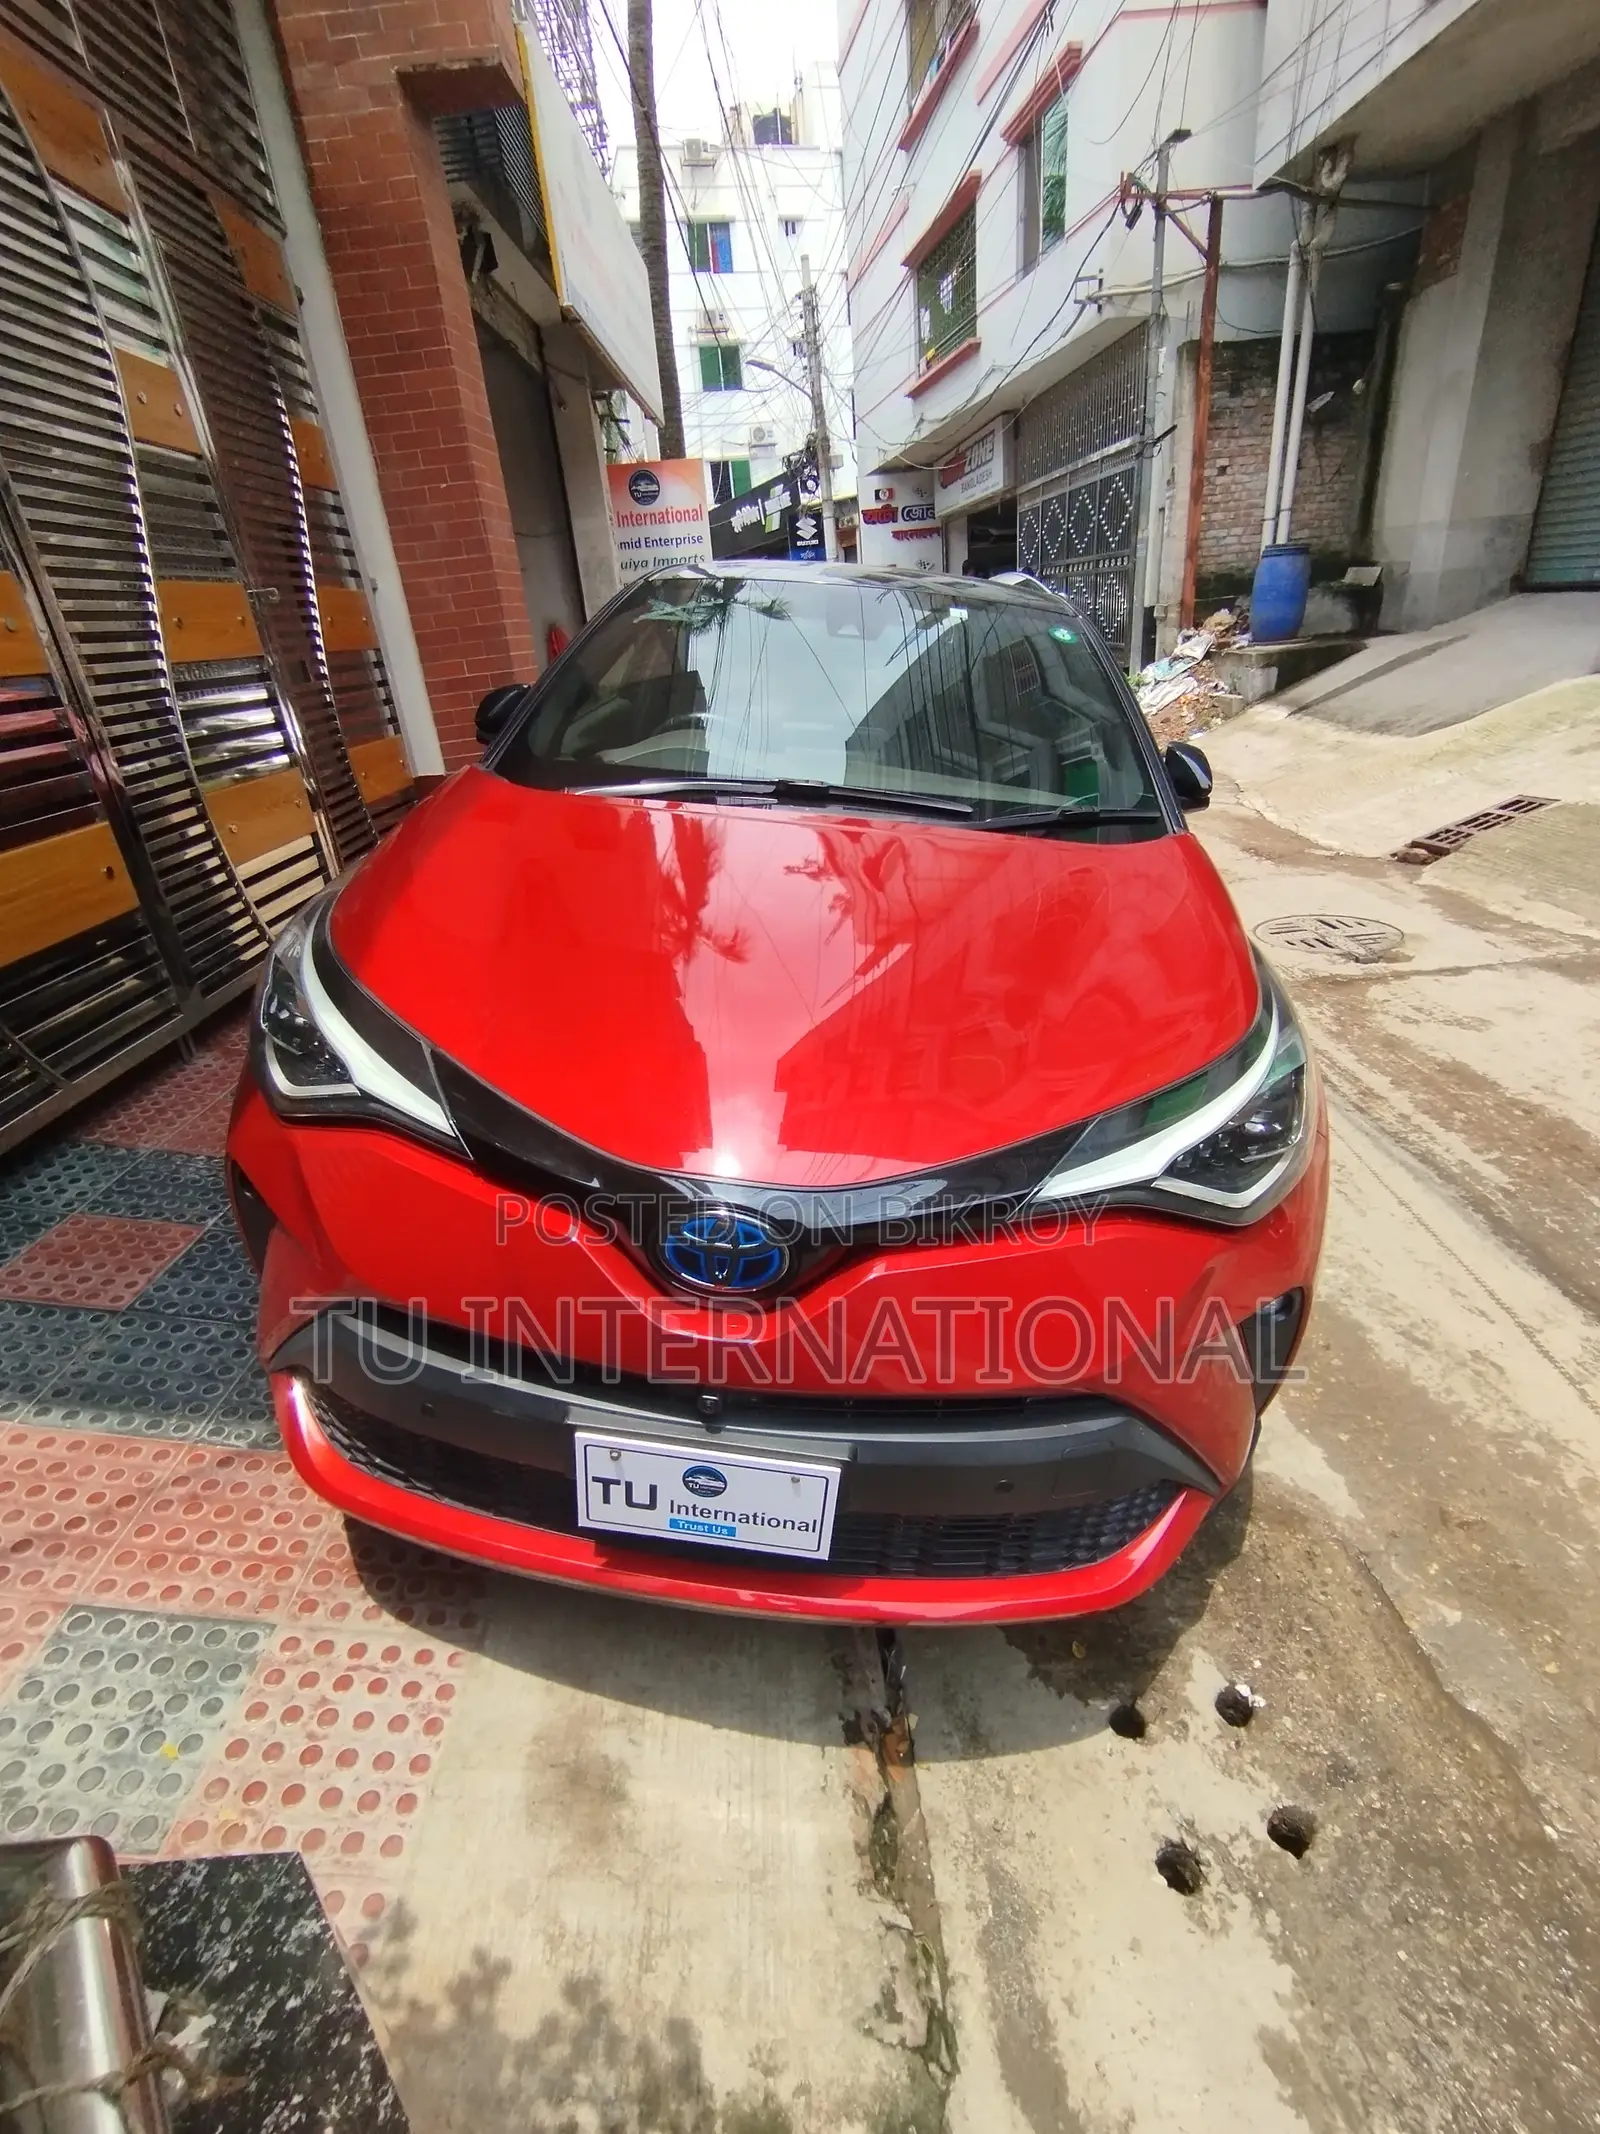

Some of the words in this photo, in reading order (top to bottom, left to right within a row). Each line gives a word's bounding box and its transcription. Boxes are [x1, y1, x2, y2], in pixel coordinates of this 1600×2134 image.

[961, 468, 993, 494] BANGLADESH
[616, 504, 703, 528] International
[618, 537, 641, 550] mid
[644, 533, 703, 548] Enterprise
[653, 554, 705, 567] Imports
[591, 1476, 658, 1511] TU
[669, 1499, 818, 1533] International
[677, 1520, 708, 1533] Trust
[712, 1522, 729, 1535] Us
